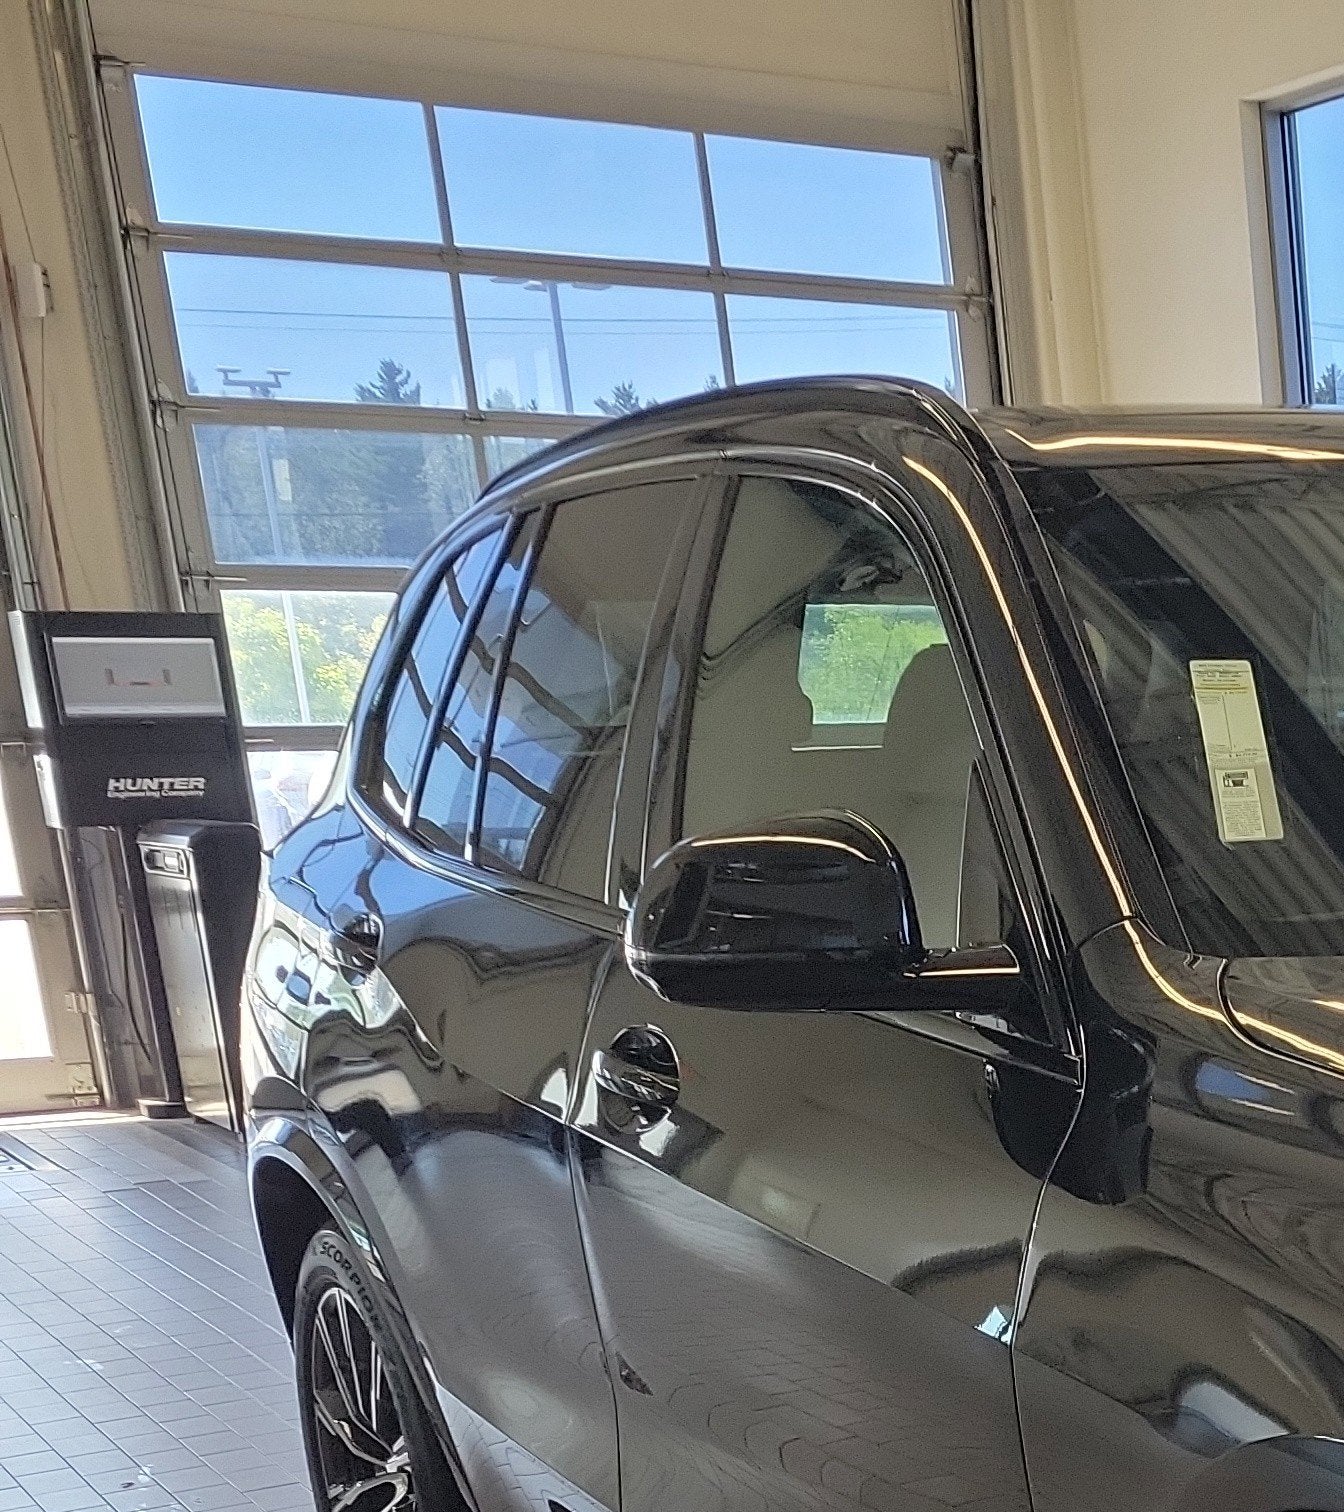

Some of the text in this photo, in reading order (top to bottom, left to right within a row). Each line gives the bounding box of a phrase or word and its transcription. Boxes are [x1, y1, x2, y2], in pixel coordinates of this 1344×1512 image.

[108, 777, 205, 791] HUNTER
[107, 789, 205, 798] Engineering Company
[320, 1241, 383, 1331] SCORPION
